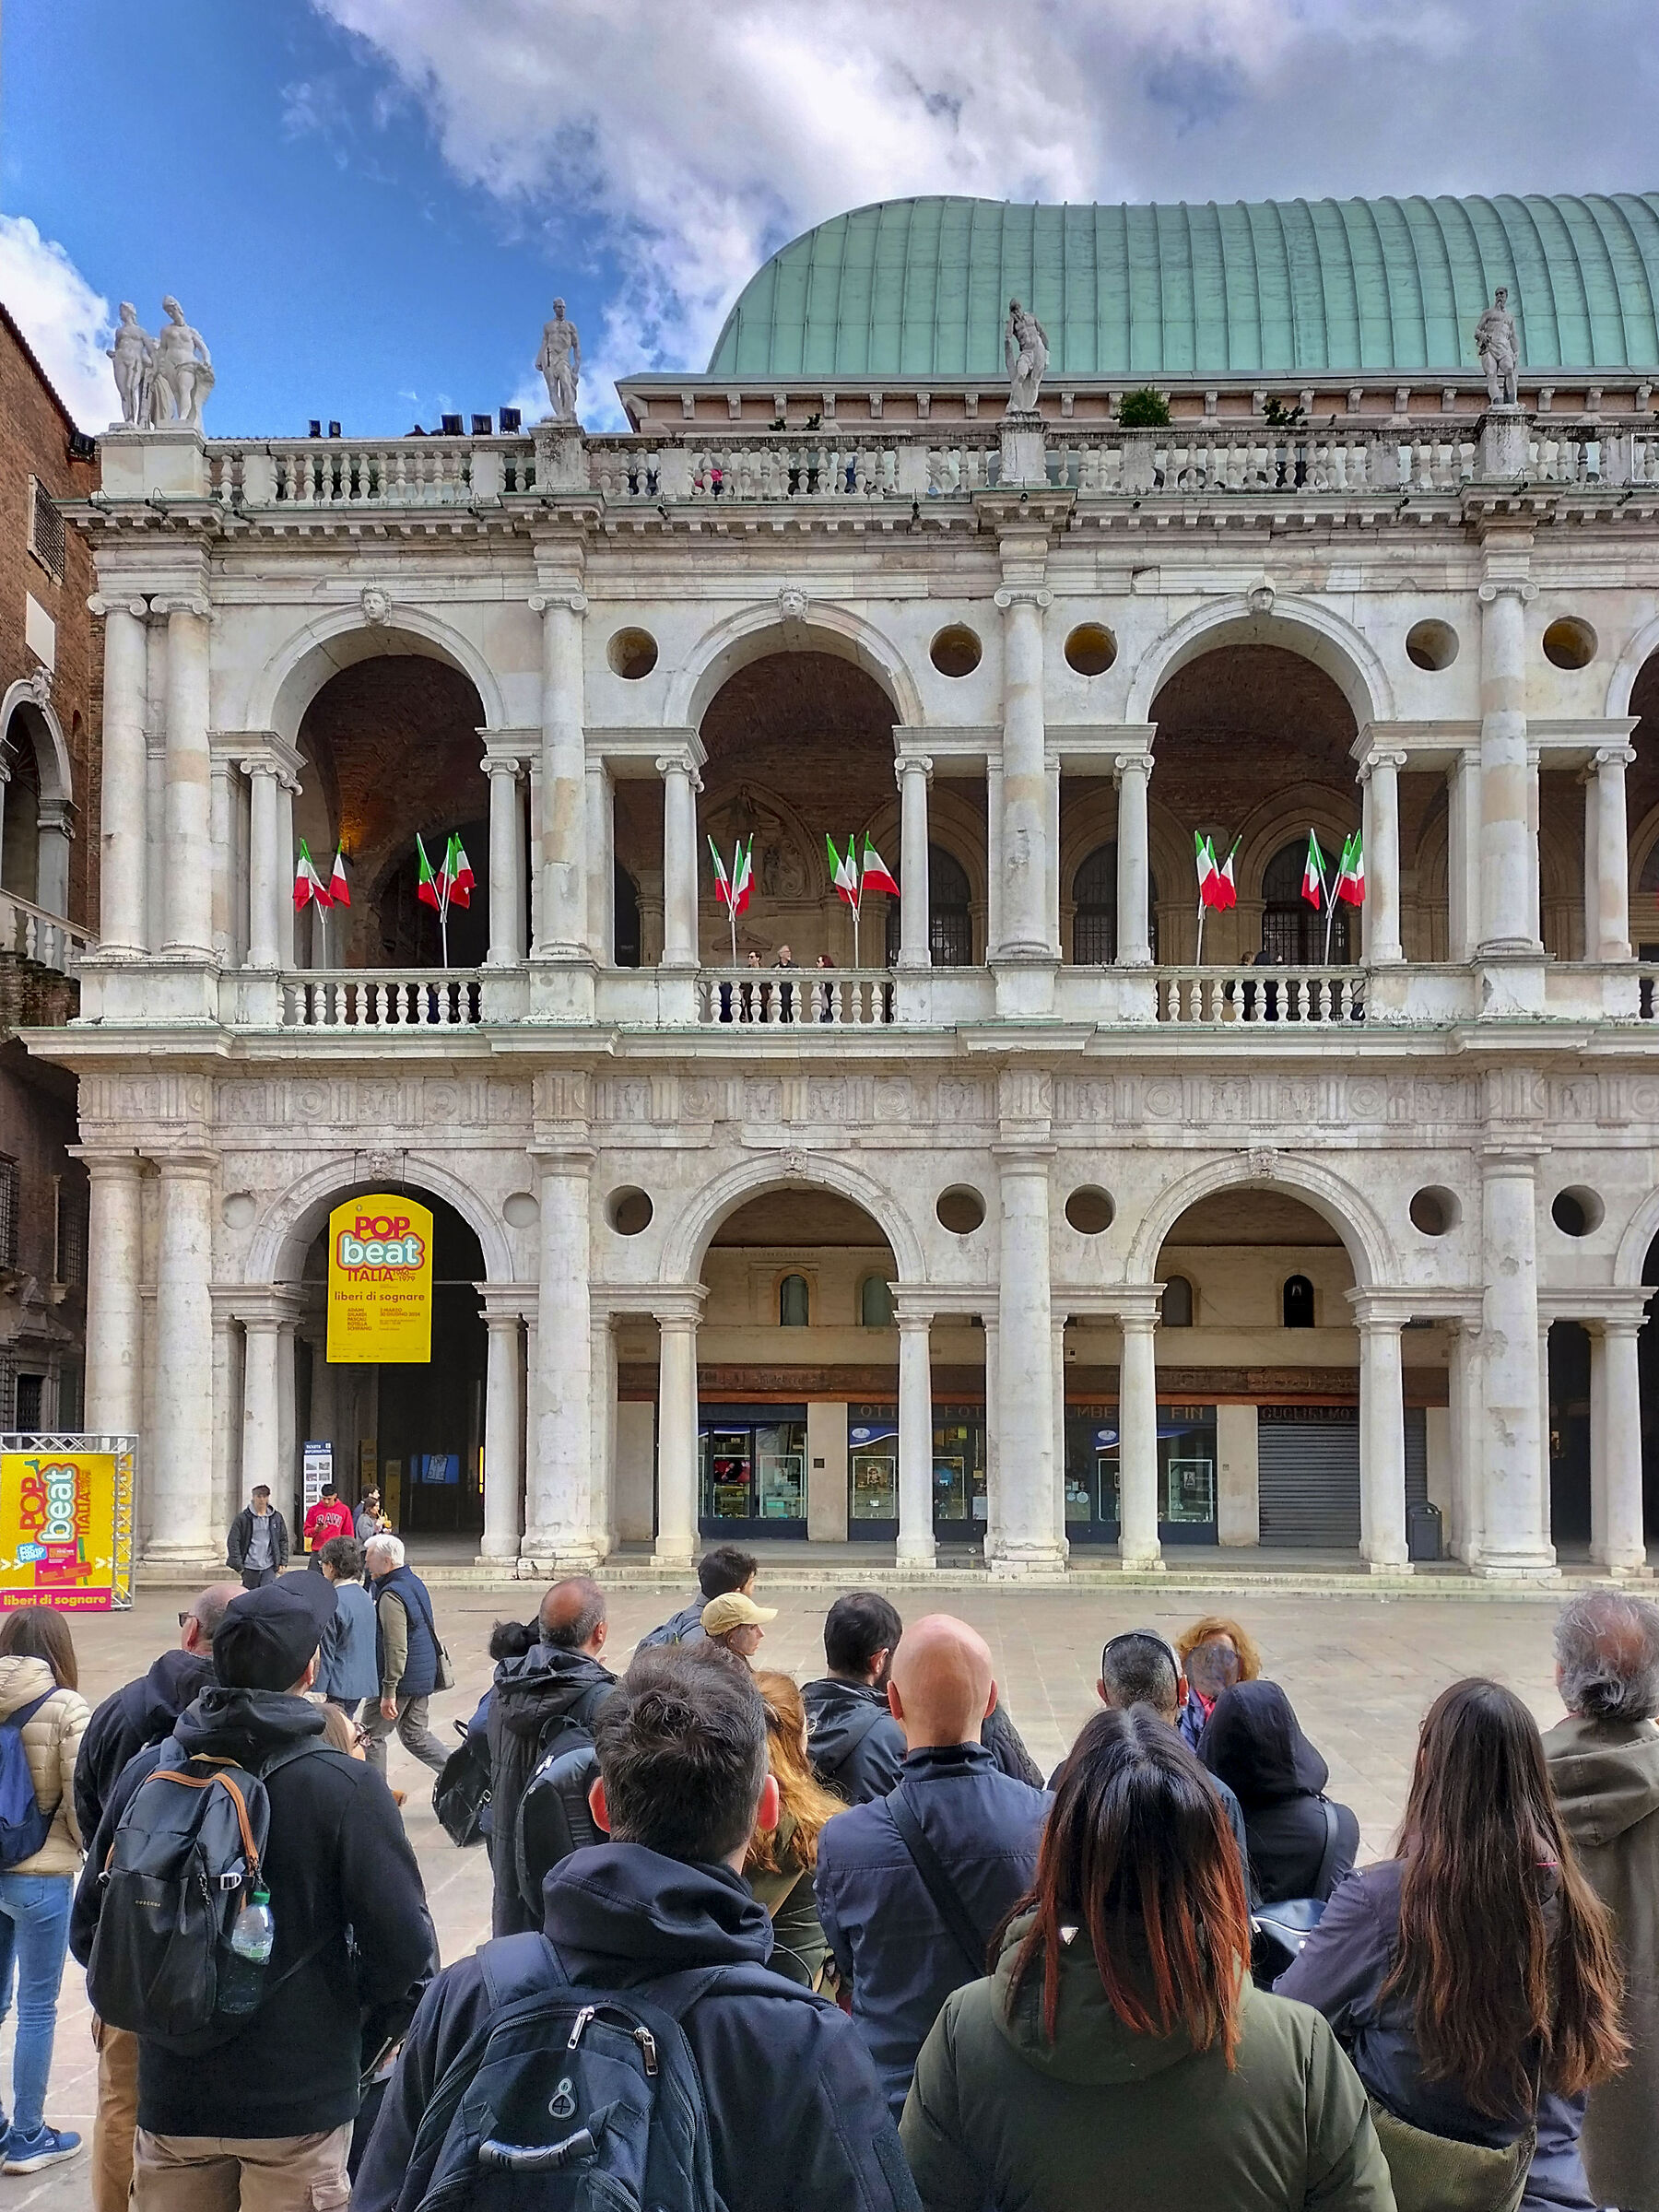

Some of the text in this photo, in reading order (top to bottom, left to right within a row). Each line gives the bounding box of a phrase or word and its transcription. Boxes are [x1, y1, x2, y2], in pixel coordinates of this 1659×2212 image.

[355, 1216, 410, 1239] POP
[344, 1237, 418, 1264] beat
[347, 1268, 394, 1281] ITALIA
[334, 1291, 425, 1303] liberi di sognare
[860, 1405, 898, 1418] OTT
[945, 1406, 983, 1418] FOT
[1171, 1406, 1204, 1419] FIN
[20, 1477, 43, 1530] POP
[41, 1469, 72, 1542] beat
[77, 1489, 90, 1535] ITALIA
[3, 1594, 106, 1606] liberi di sognare
